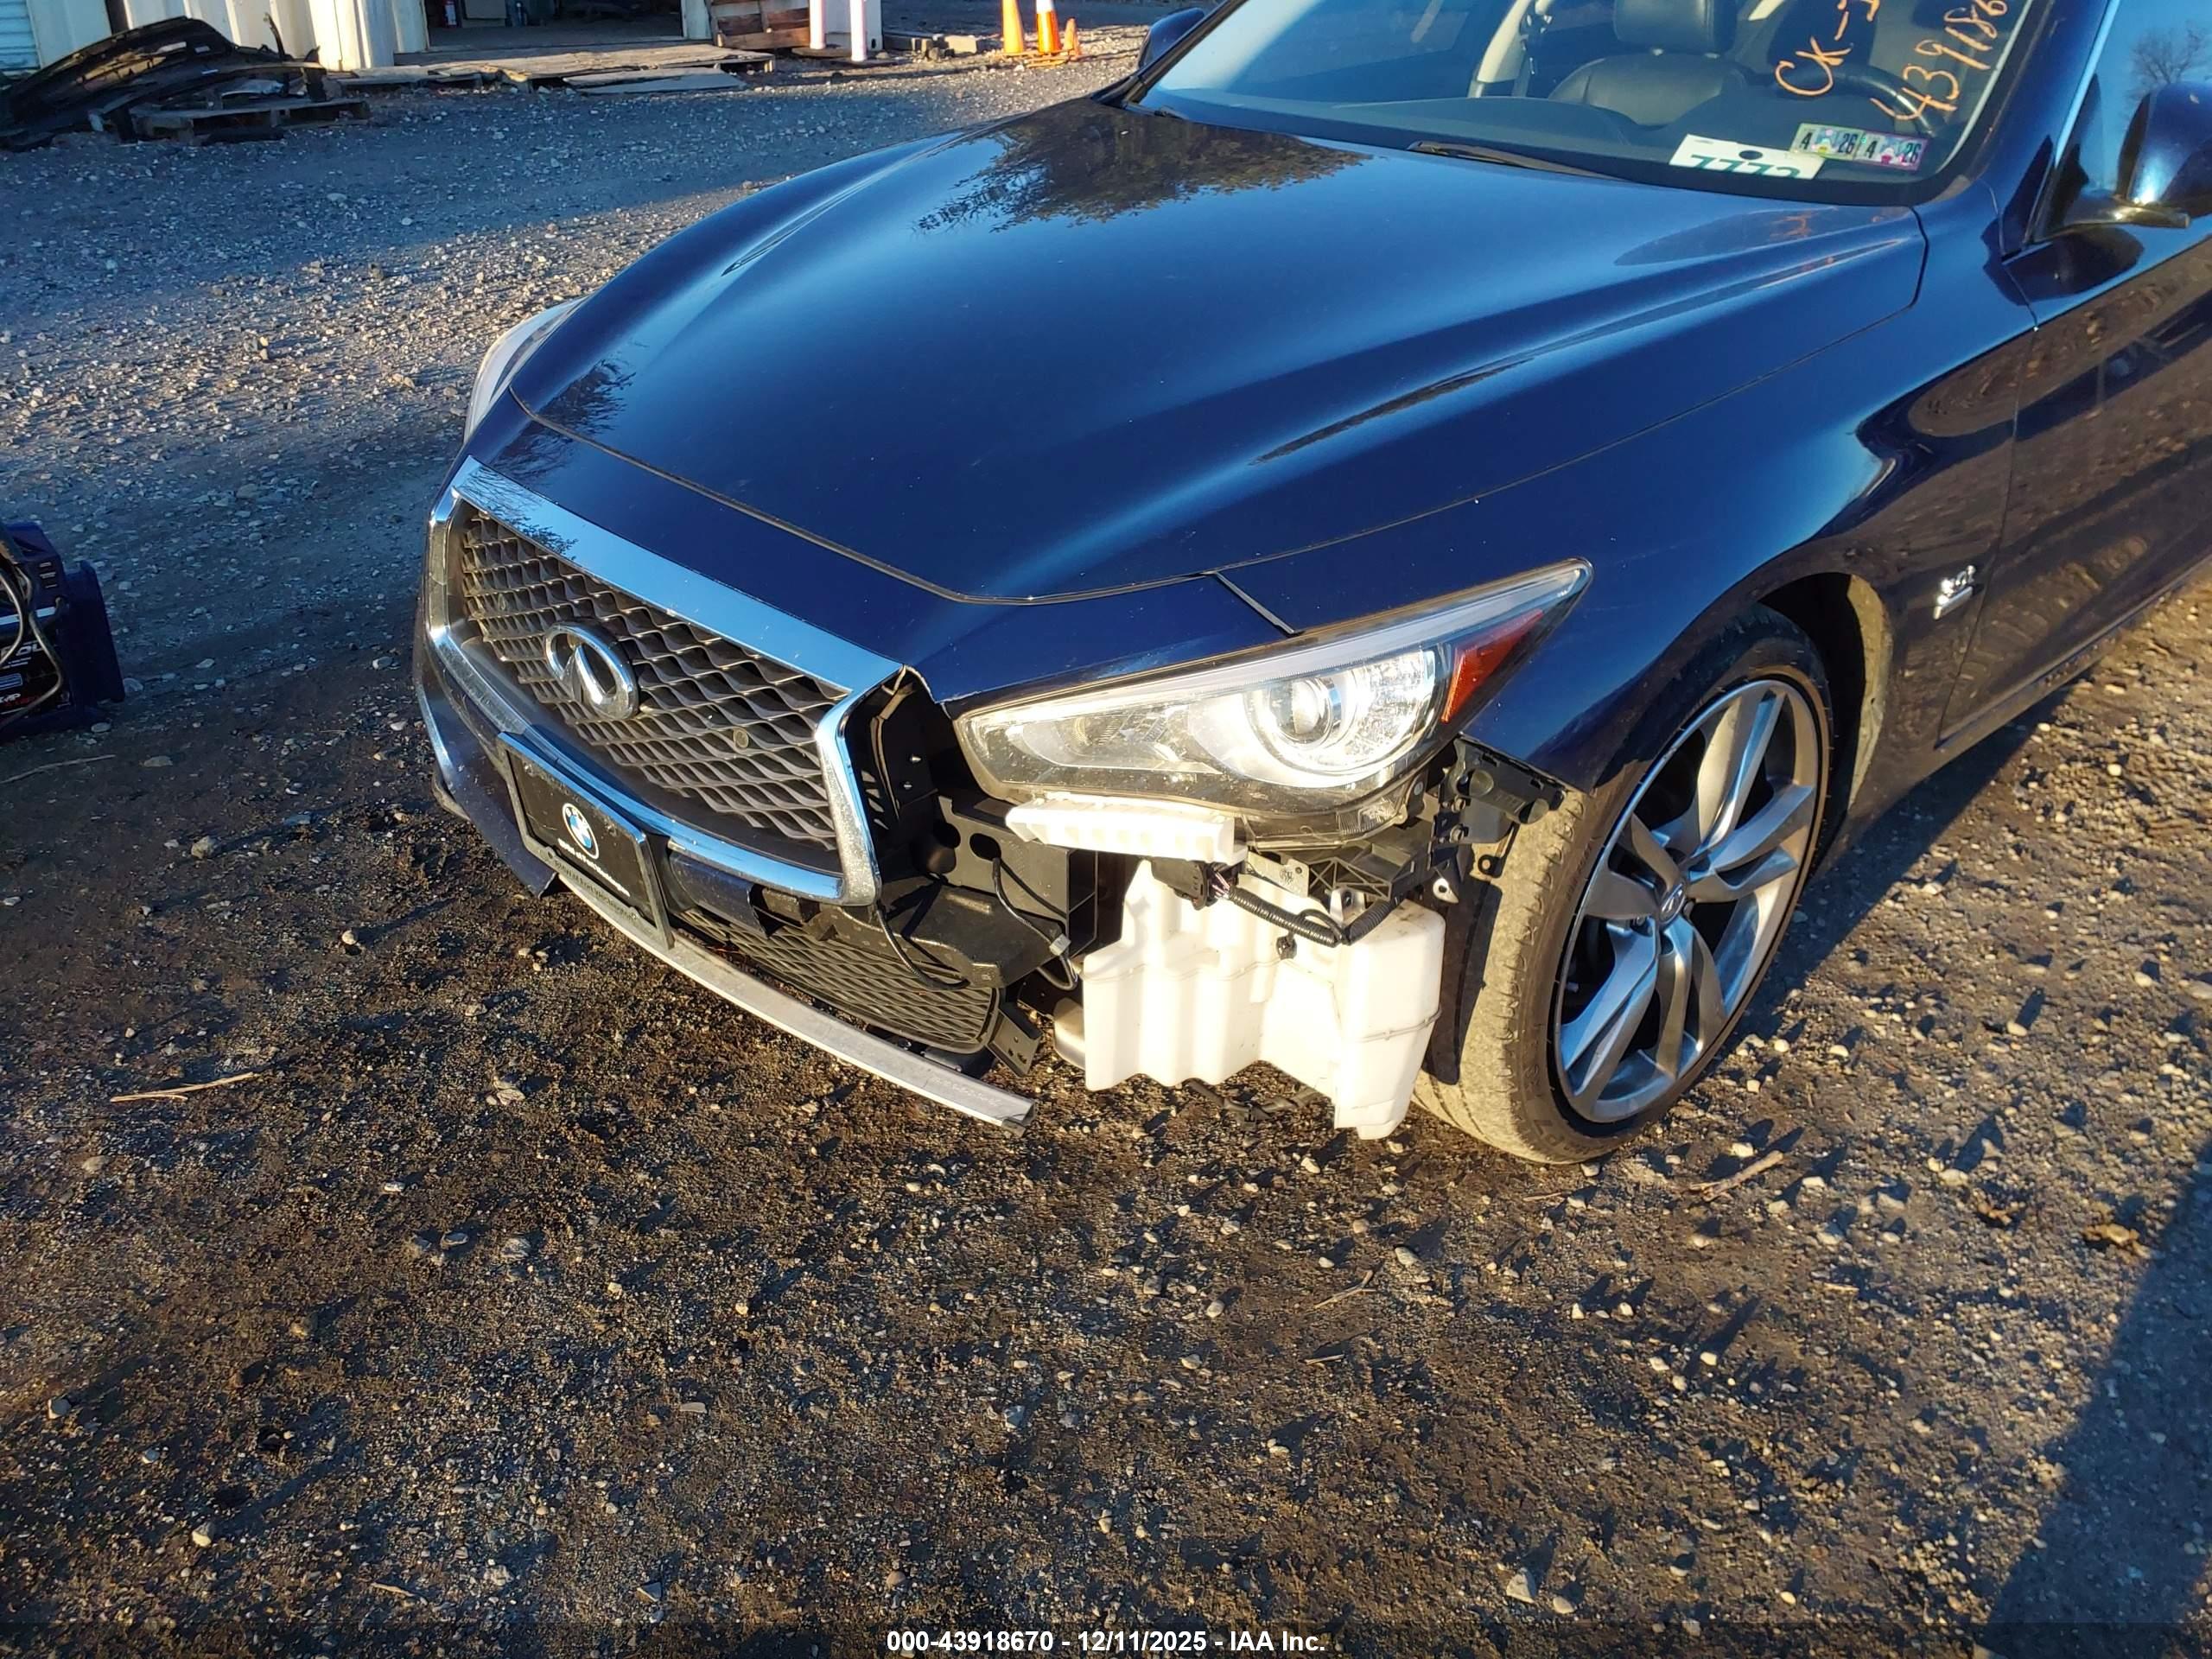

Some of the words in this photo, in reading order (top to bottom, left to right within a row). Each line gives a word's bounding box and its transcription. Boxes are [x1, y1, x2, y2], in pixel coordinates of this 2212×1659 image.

[1801, 132, 1813, 150] 4
[1838, 132, 1859, 155] 26
[1866, 140, 1878, 159] 4
[1901, 142, 1923, 164] 26
